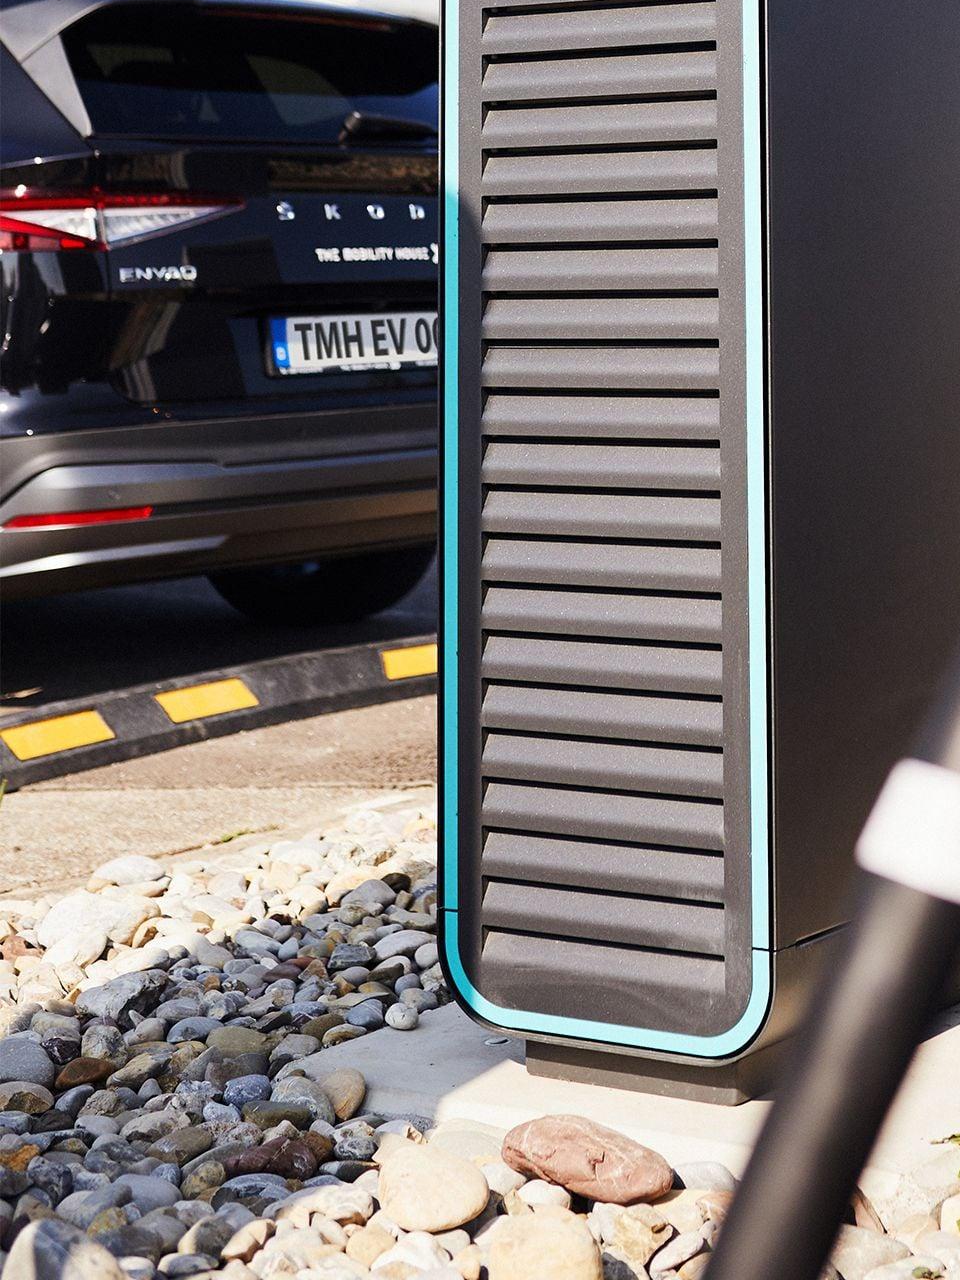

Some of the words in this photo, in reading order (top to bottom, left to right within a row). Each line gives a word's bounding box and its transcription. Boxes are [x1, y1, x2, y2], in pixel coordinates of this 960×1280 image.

[294, 320, 364, 361] TMH
[370, 318, 407, 356] EV
[414, 317, 438, 354] 0
